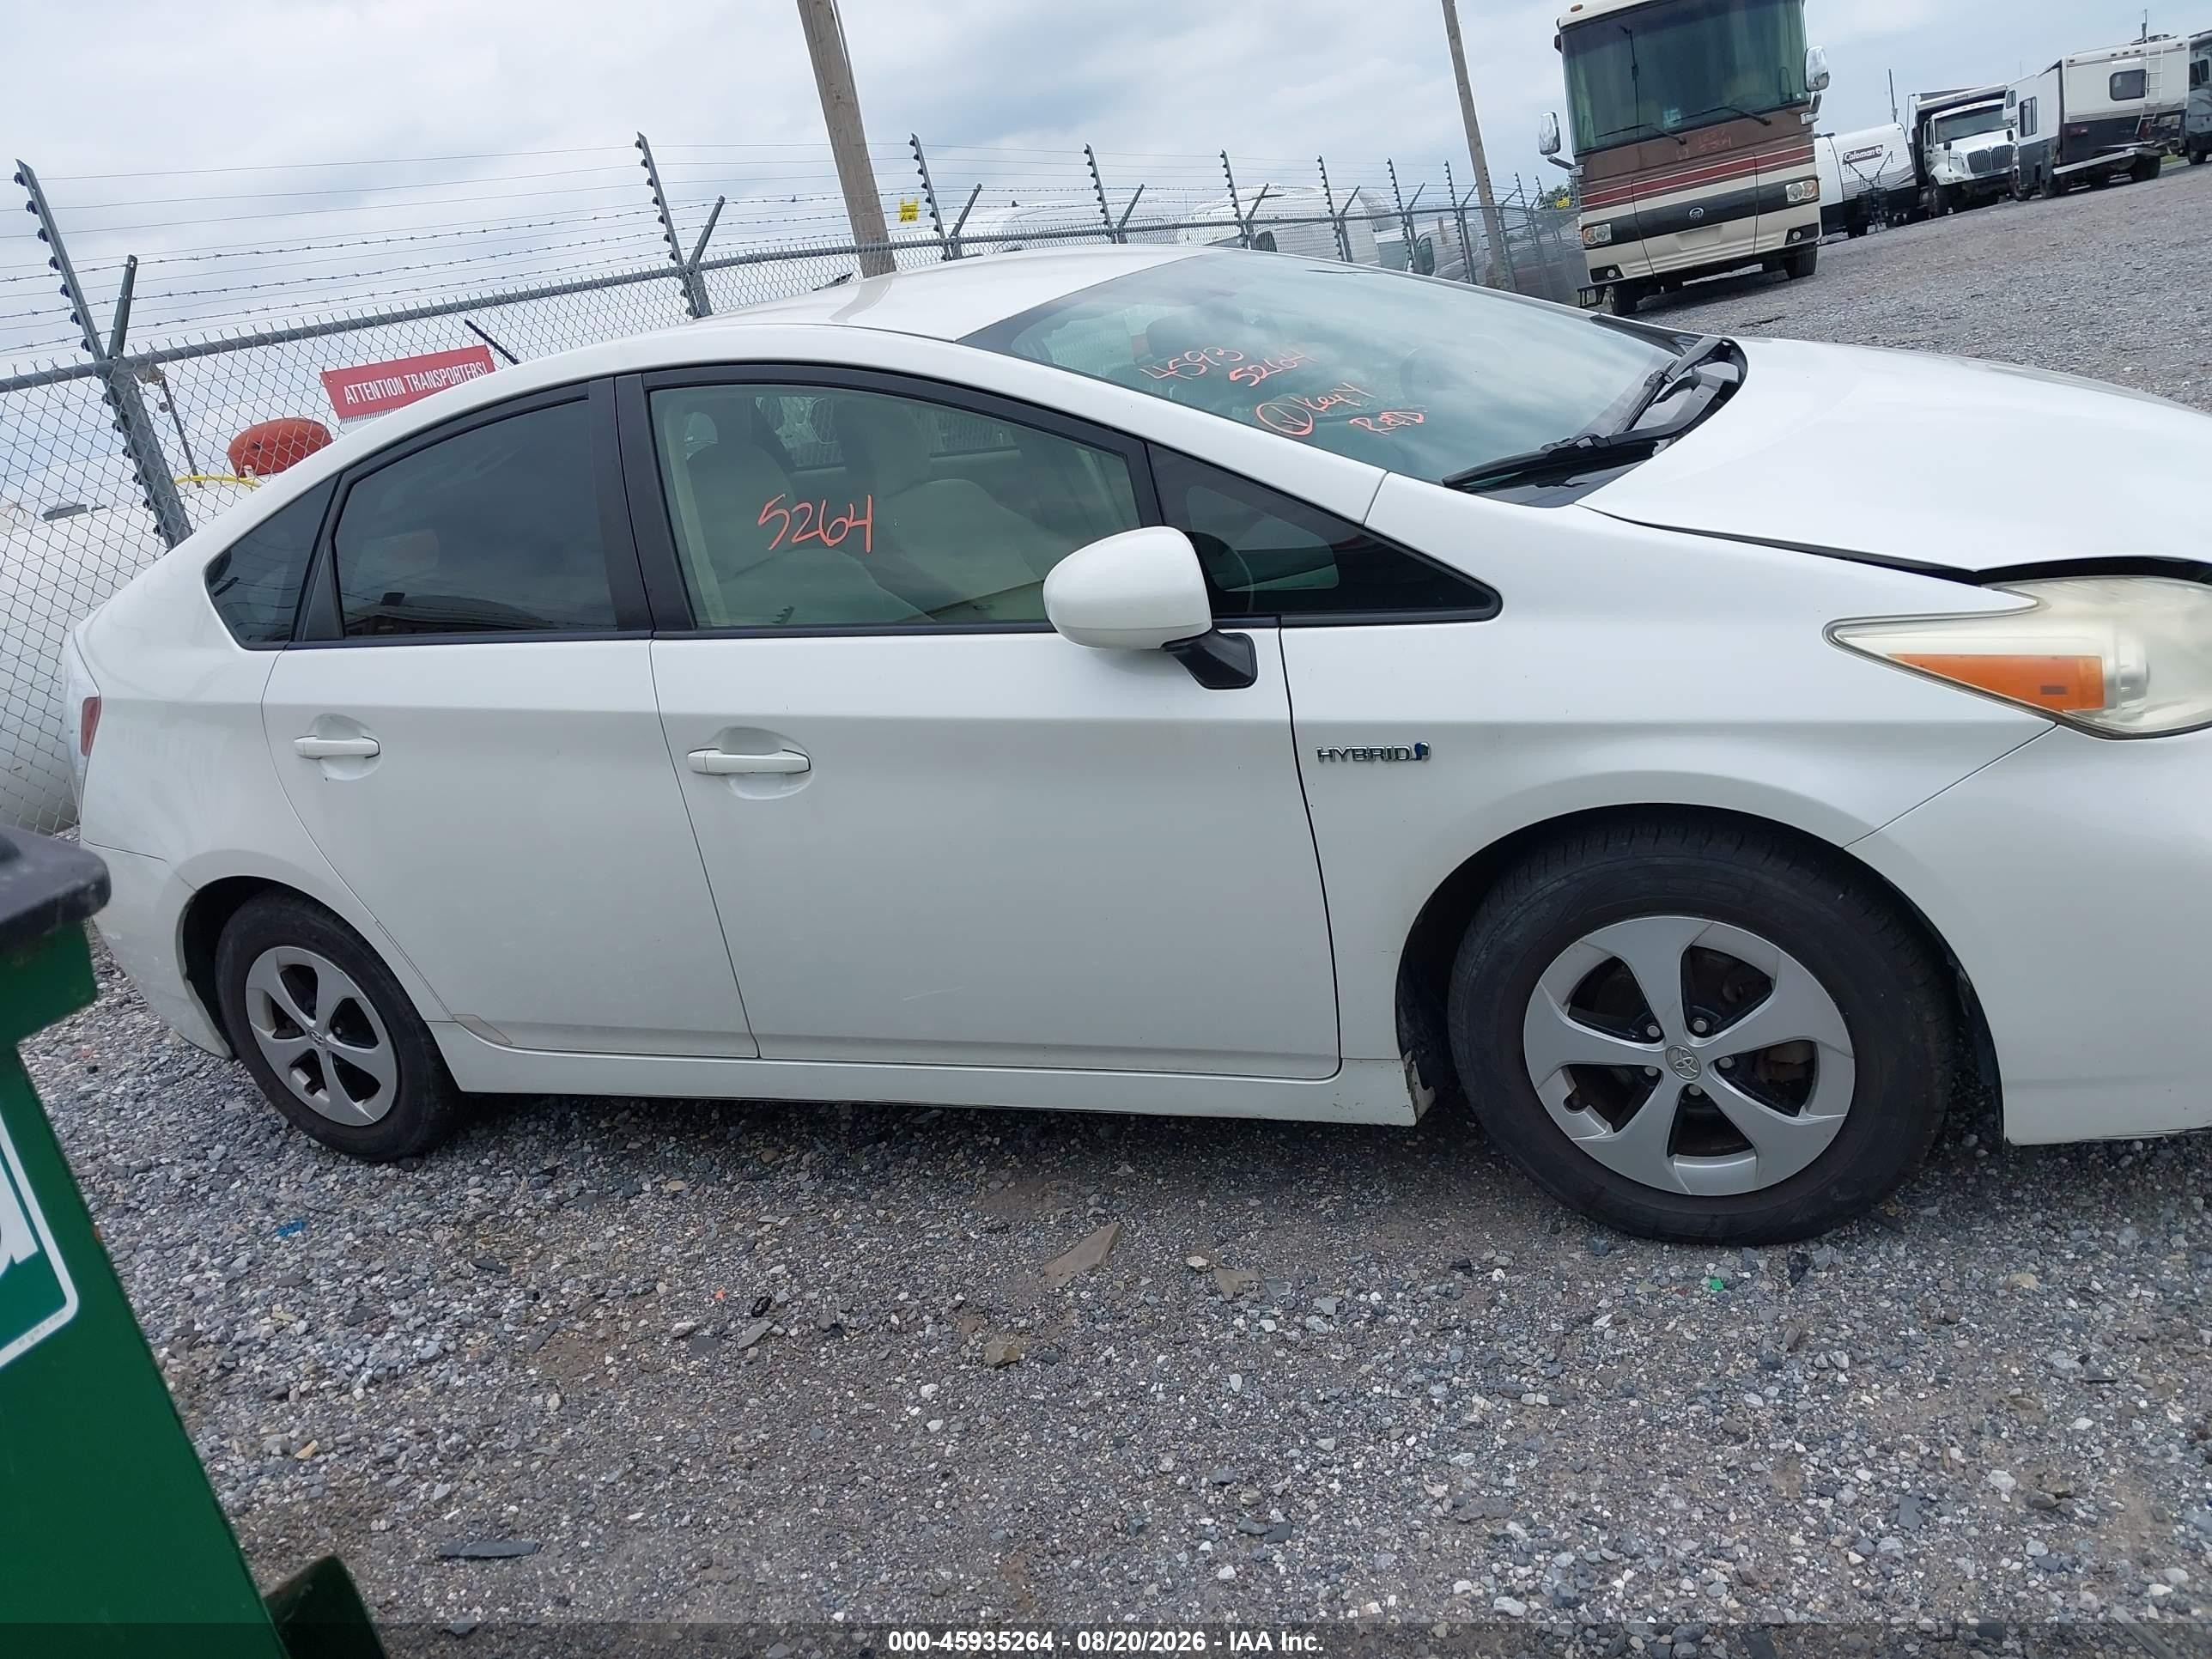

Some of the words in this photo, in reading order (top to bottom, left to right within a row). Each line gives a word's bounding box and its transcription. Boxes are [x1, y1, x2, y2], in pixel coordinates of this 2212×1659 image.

[1844, 149, 1875, 161] Coleman
[1139, 346, 1244, 380] 4593
[1229, 348, 1320, 386] 5264
[343, 376, 406, 404] ATTENTION
[404, 361, 488, 392] TRANSPORTERS!
[757, 493, 872, 553] 5264
[1316, 745, 1411, 763] HYBRID
